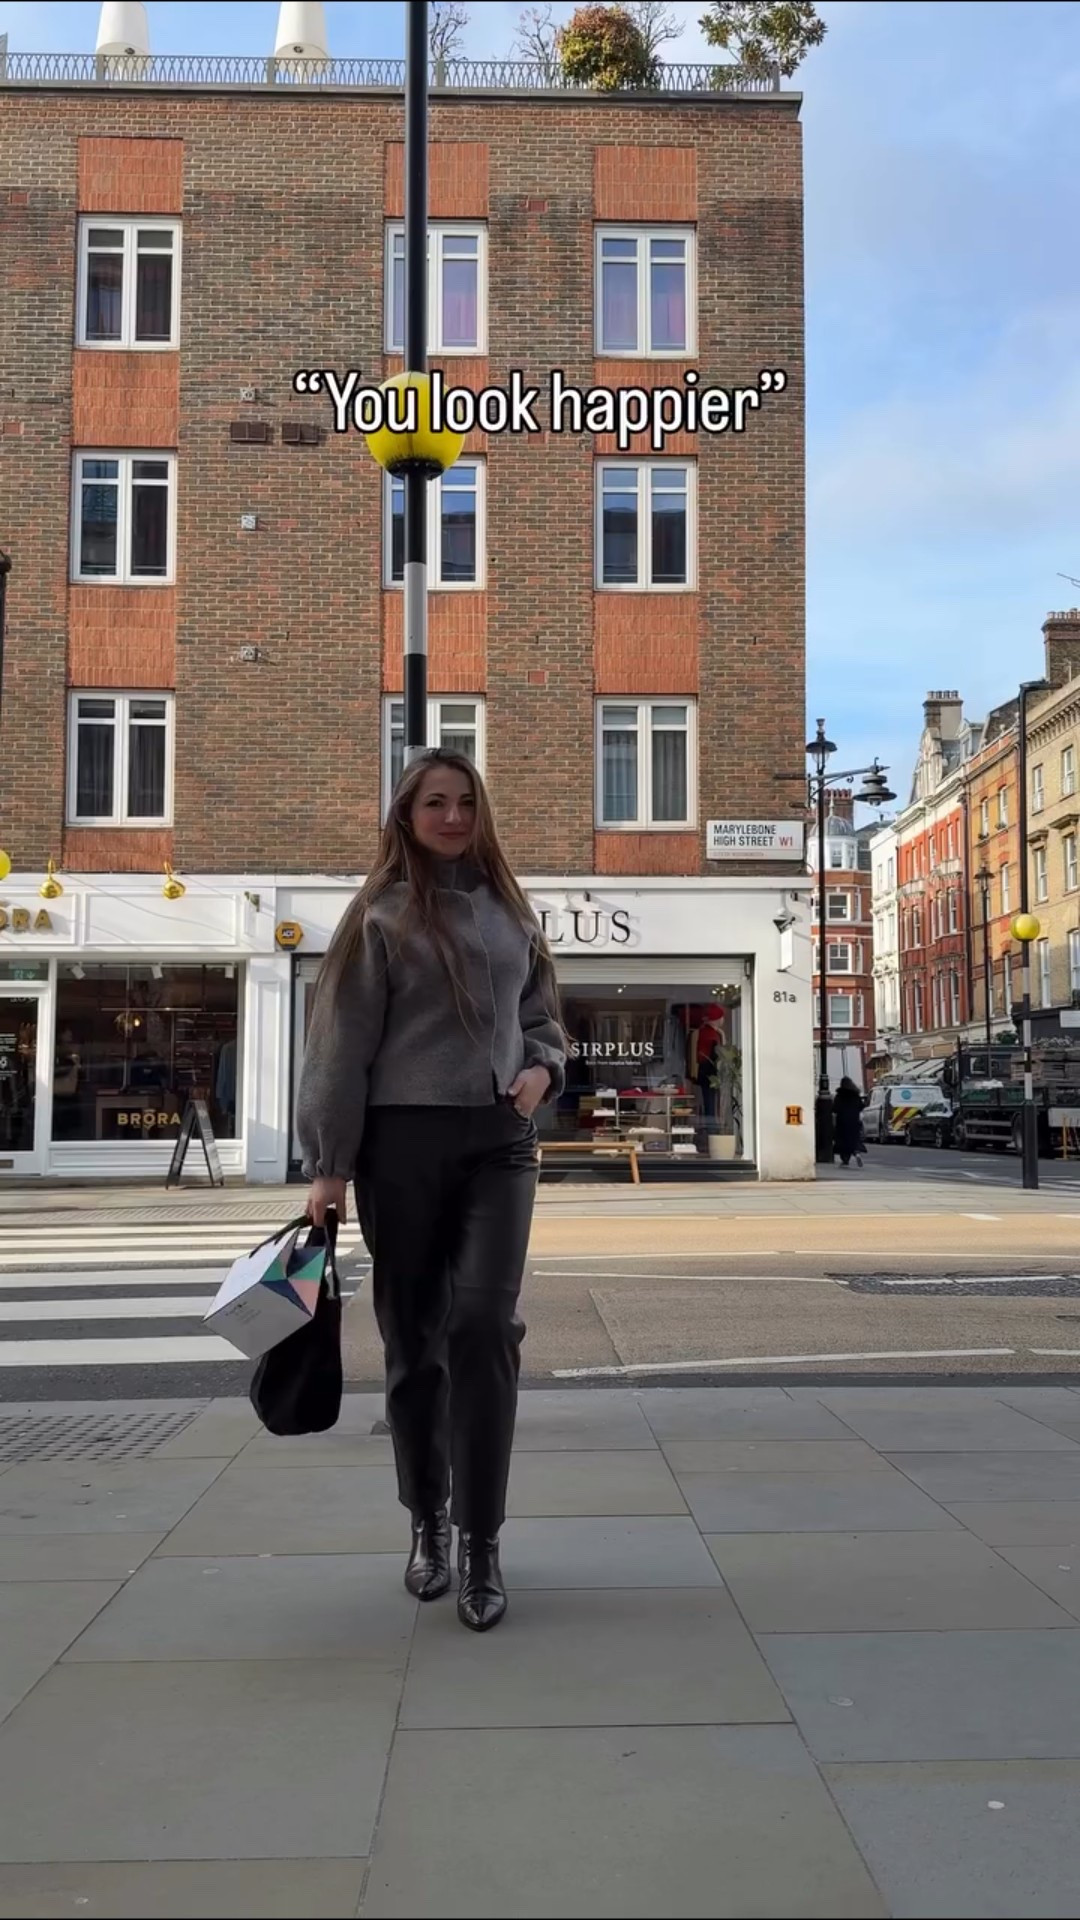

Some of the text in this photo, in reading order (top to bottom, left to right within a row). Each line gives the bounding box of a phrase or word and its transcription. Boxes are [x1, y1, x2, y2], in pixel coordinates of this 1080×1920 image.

[713, 824, 777, 835] MARYLEBONE
[713, 836, 793, 847] HIGH STREET W1
[773, 990, 797, 1003] 81a
[571, 1042, 655, 1057] SIRPLUS
[117, 1111, 181, 1126] BRORA
